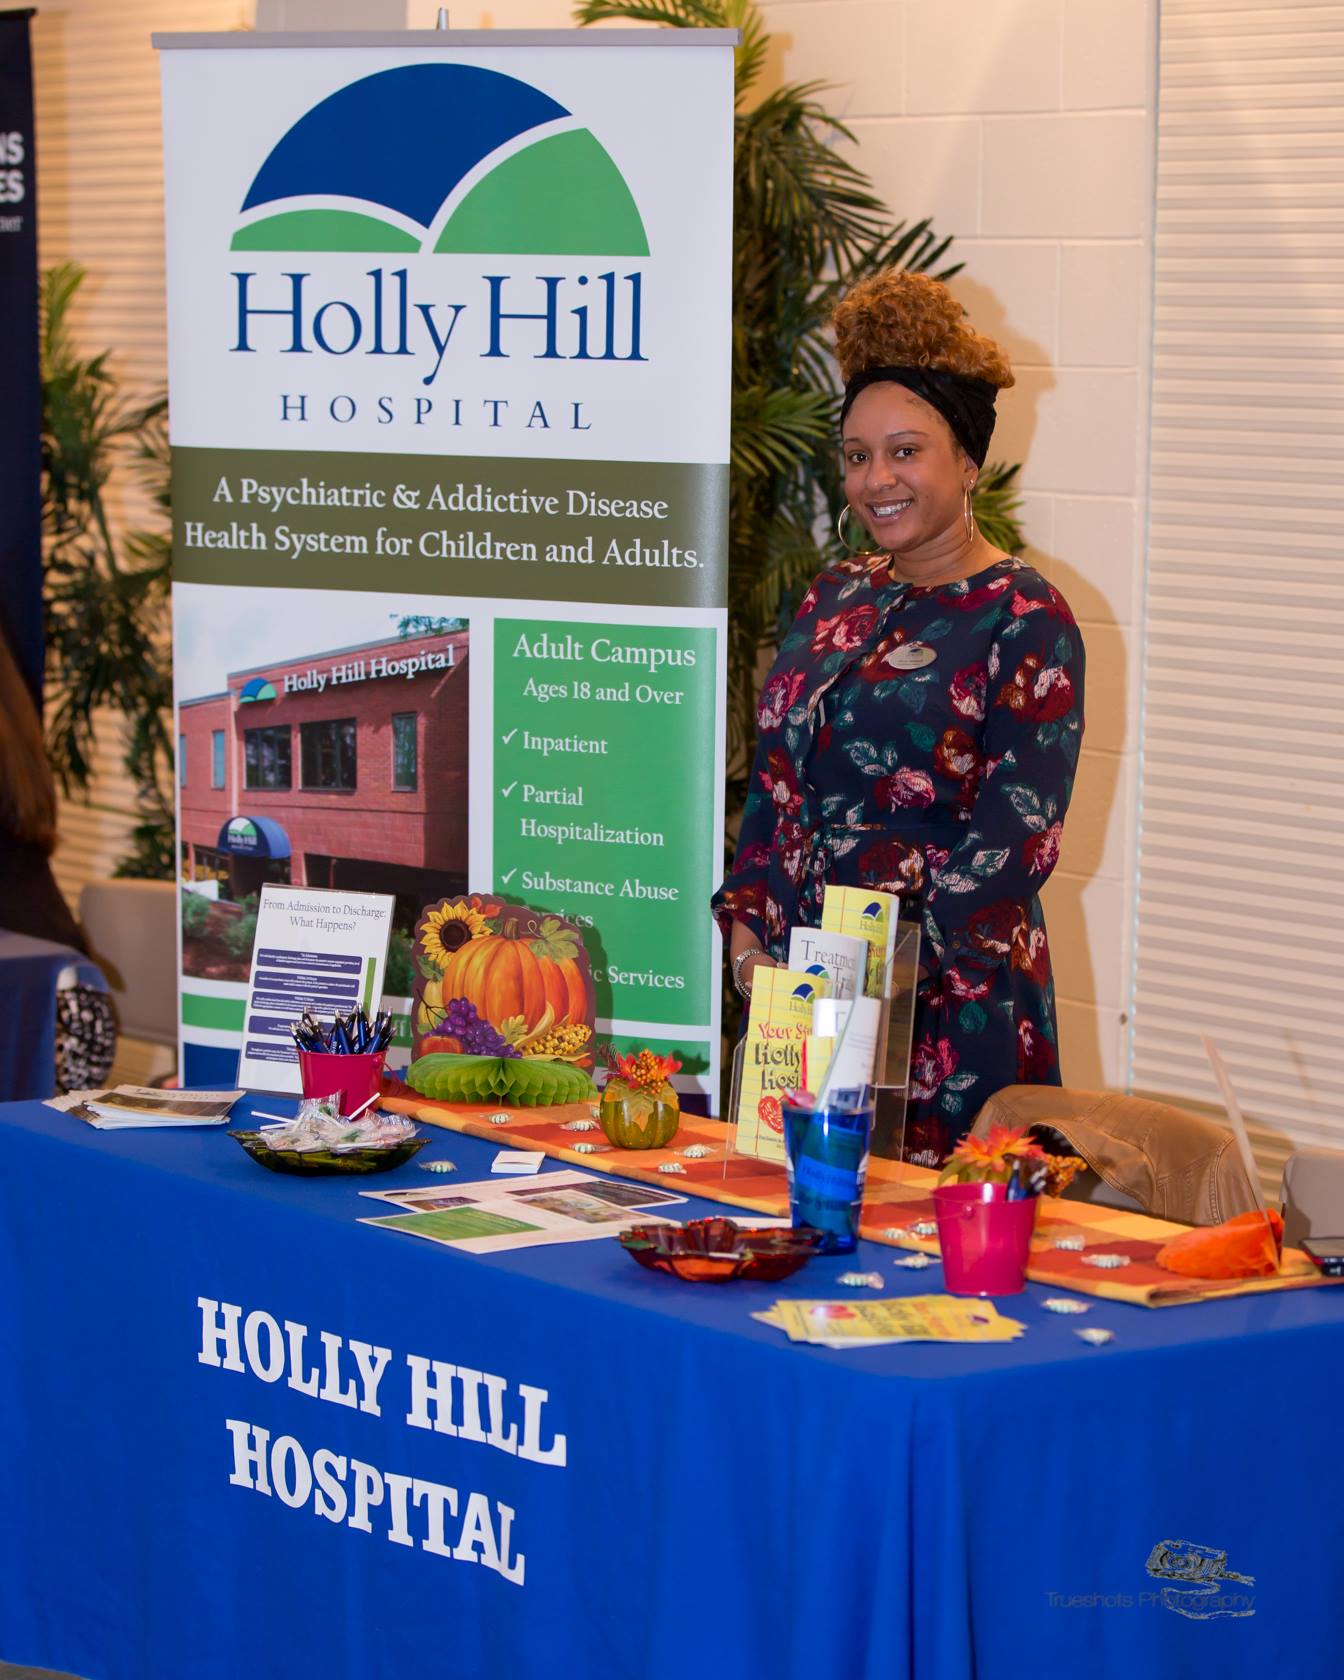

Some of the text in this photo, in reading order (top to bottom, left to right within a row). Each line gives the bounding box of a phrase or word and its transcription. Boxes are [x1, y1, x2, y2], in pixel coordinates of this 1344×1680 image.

[229, 268, 649, 386] Holly Hill
[280, 394, 592, 430] HOSPITAL
[213, 476, 668, 519] A Psychiatric & Addictive Disease
[184, 522, 704, 568] Health System for Children and Adults.
[512, 633, 696, 673] Adult Campus
[283, 644, 455, 693] Holly Hill Hospital
[523, 677, 684, 705] Ages 18 and Over
[523, 731, 608, 756] Inpatient
[523, 784, 584, 806] Partial
[520, 818, 664, 847] Hospitalization
[522, 871, 679, 901] Substance Abuse
[263, 898, 285, 911] From
[287, 901, 331, 915] Admission
[332, 905, 341, 915] to
[289, 916, 357, 933] What Happens?
[608, 966, 685, 989] Services
[758, 1022, 793, 1040] Your
[198, 1297, 567, 1467] HOLLY HILL
[226, 1418, 525, 1586] HOSPITAL
